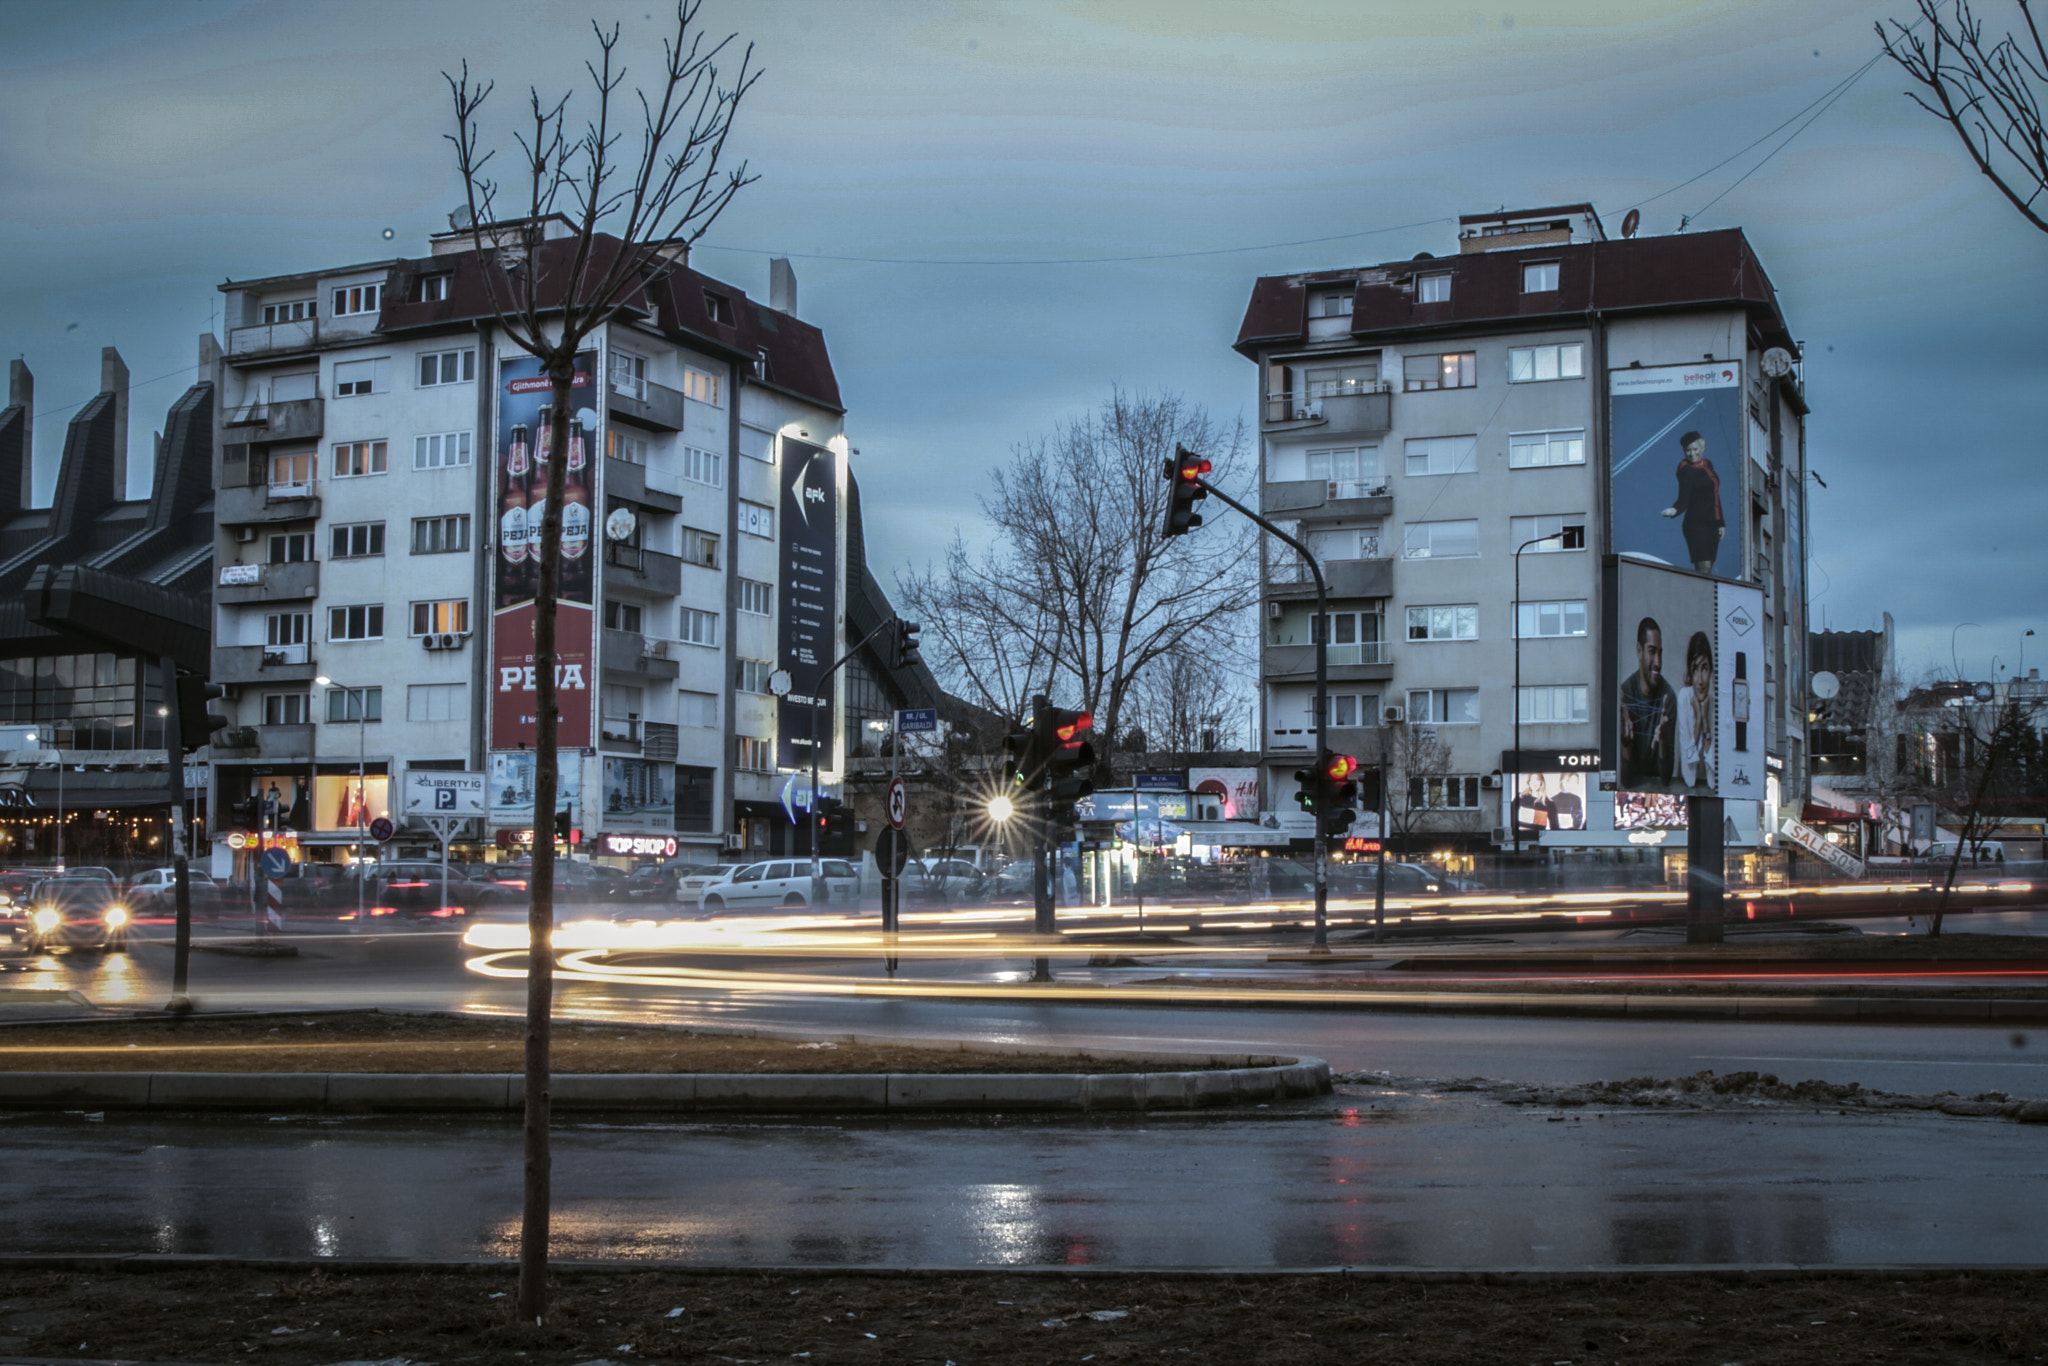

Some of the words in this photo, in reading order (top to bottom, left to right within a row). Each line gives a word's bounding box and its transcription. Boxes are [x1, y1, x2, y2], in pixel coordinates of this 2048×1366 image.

[512, 379, 548, 391] Gjithmonë
[787, 694, 807, 704] INVESTO
[901, 721, 933, 730] GARIBALDI
[428, 779, 469, 788] LIBERTY
[471, 780, 481, 788] IG
[438, 790, 452, 808] P
[607, 837, 633, 853] TOP
[633, 838, 666, 855] SHOP
[1790, 825, 1831, 857] SALE
[1828, 849, 1857, 874] 50%
